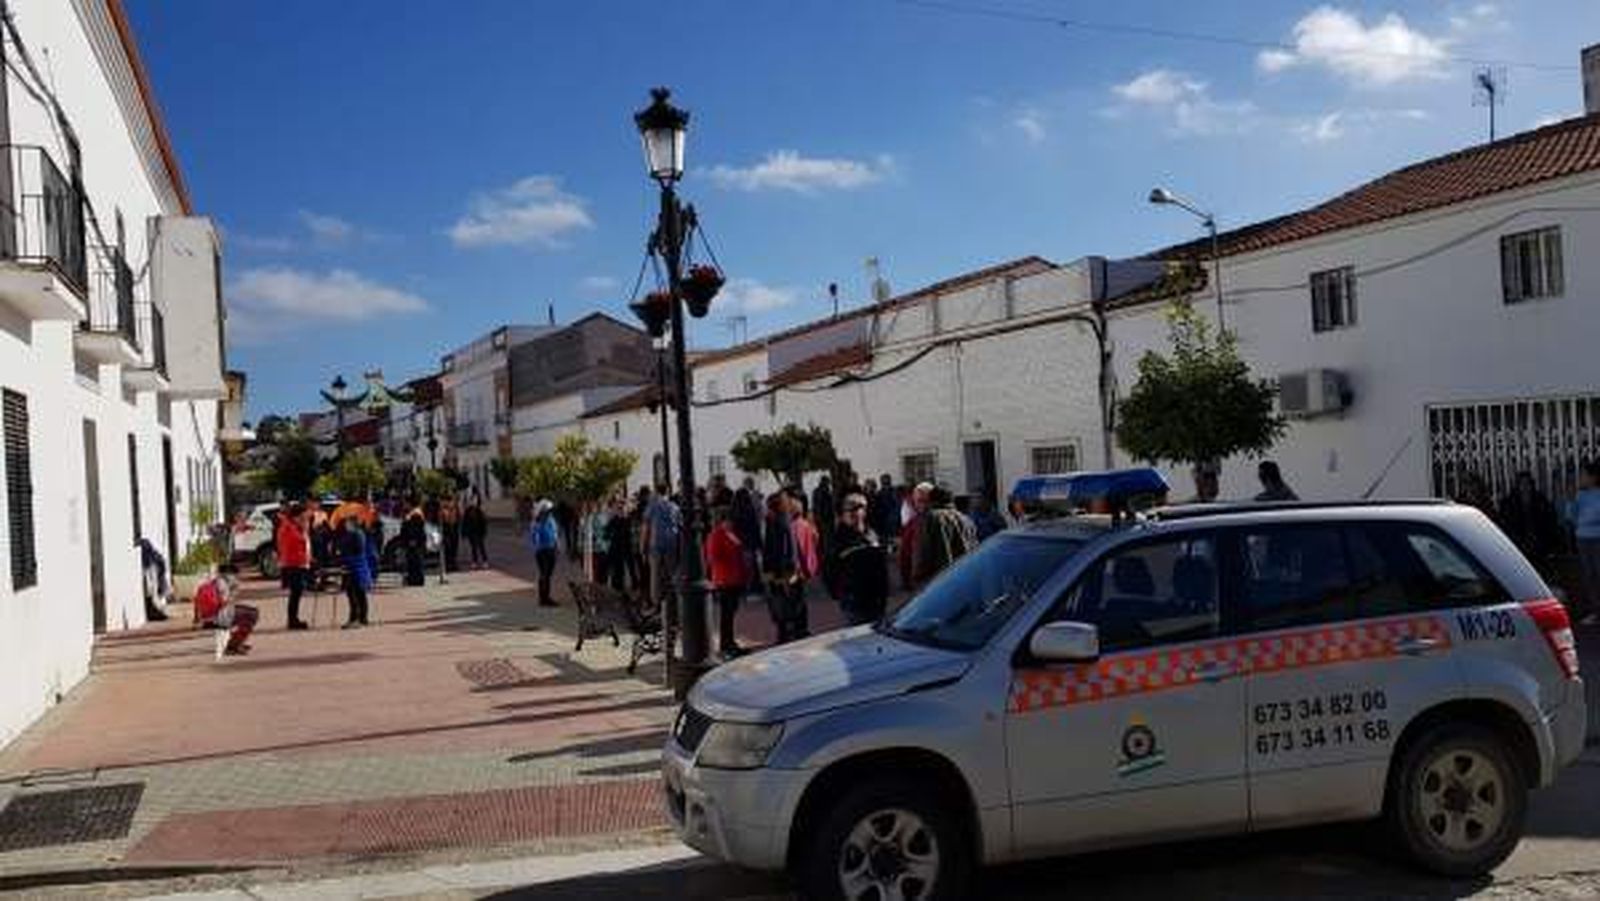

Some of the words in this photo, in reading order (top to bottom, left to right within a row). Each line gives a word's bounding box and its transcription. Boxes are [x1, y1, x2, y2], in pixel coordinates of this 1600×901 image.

[1255, 702, 1292, 724] 673
[1299, 697, 1323, 719] 34
[1362, 691, 1387, 711] 00
[1257, 731, 1294, 754] 673
[1301, 726, 1326, 748] 34
[1333, 724, 1353, 743] 11
[1364, 719, 1390, 740] 68
